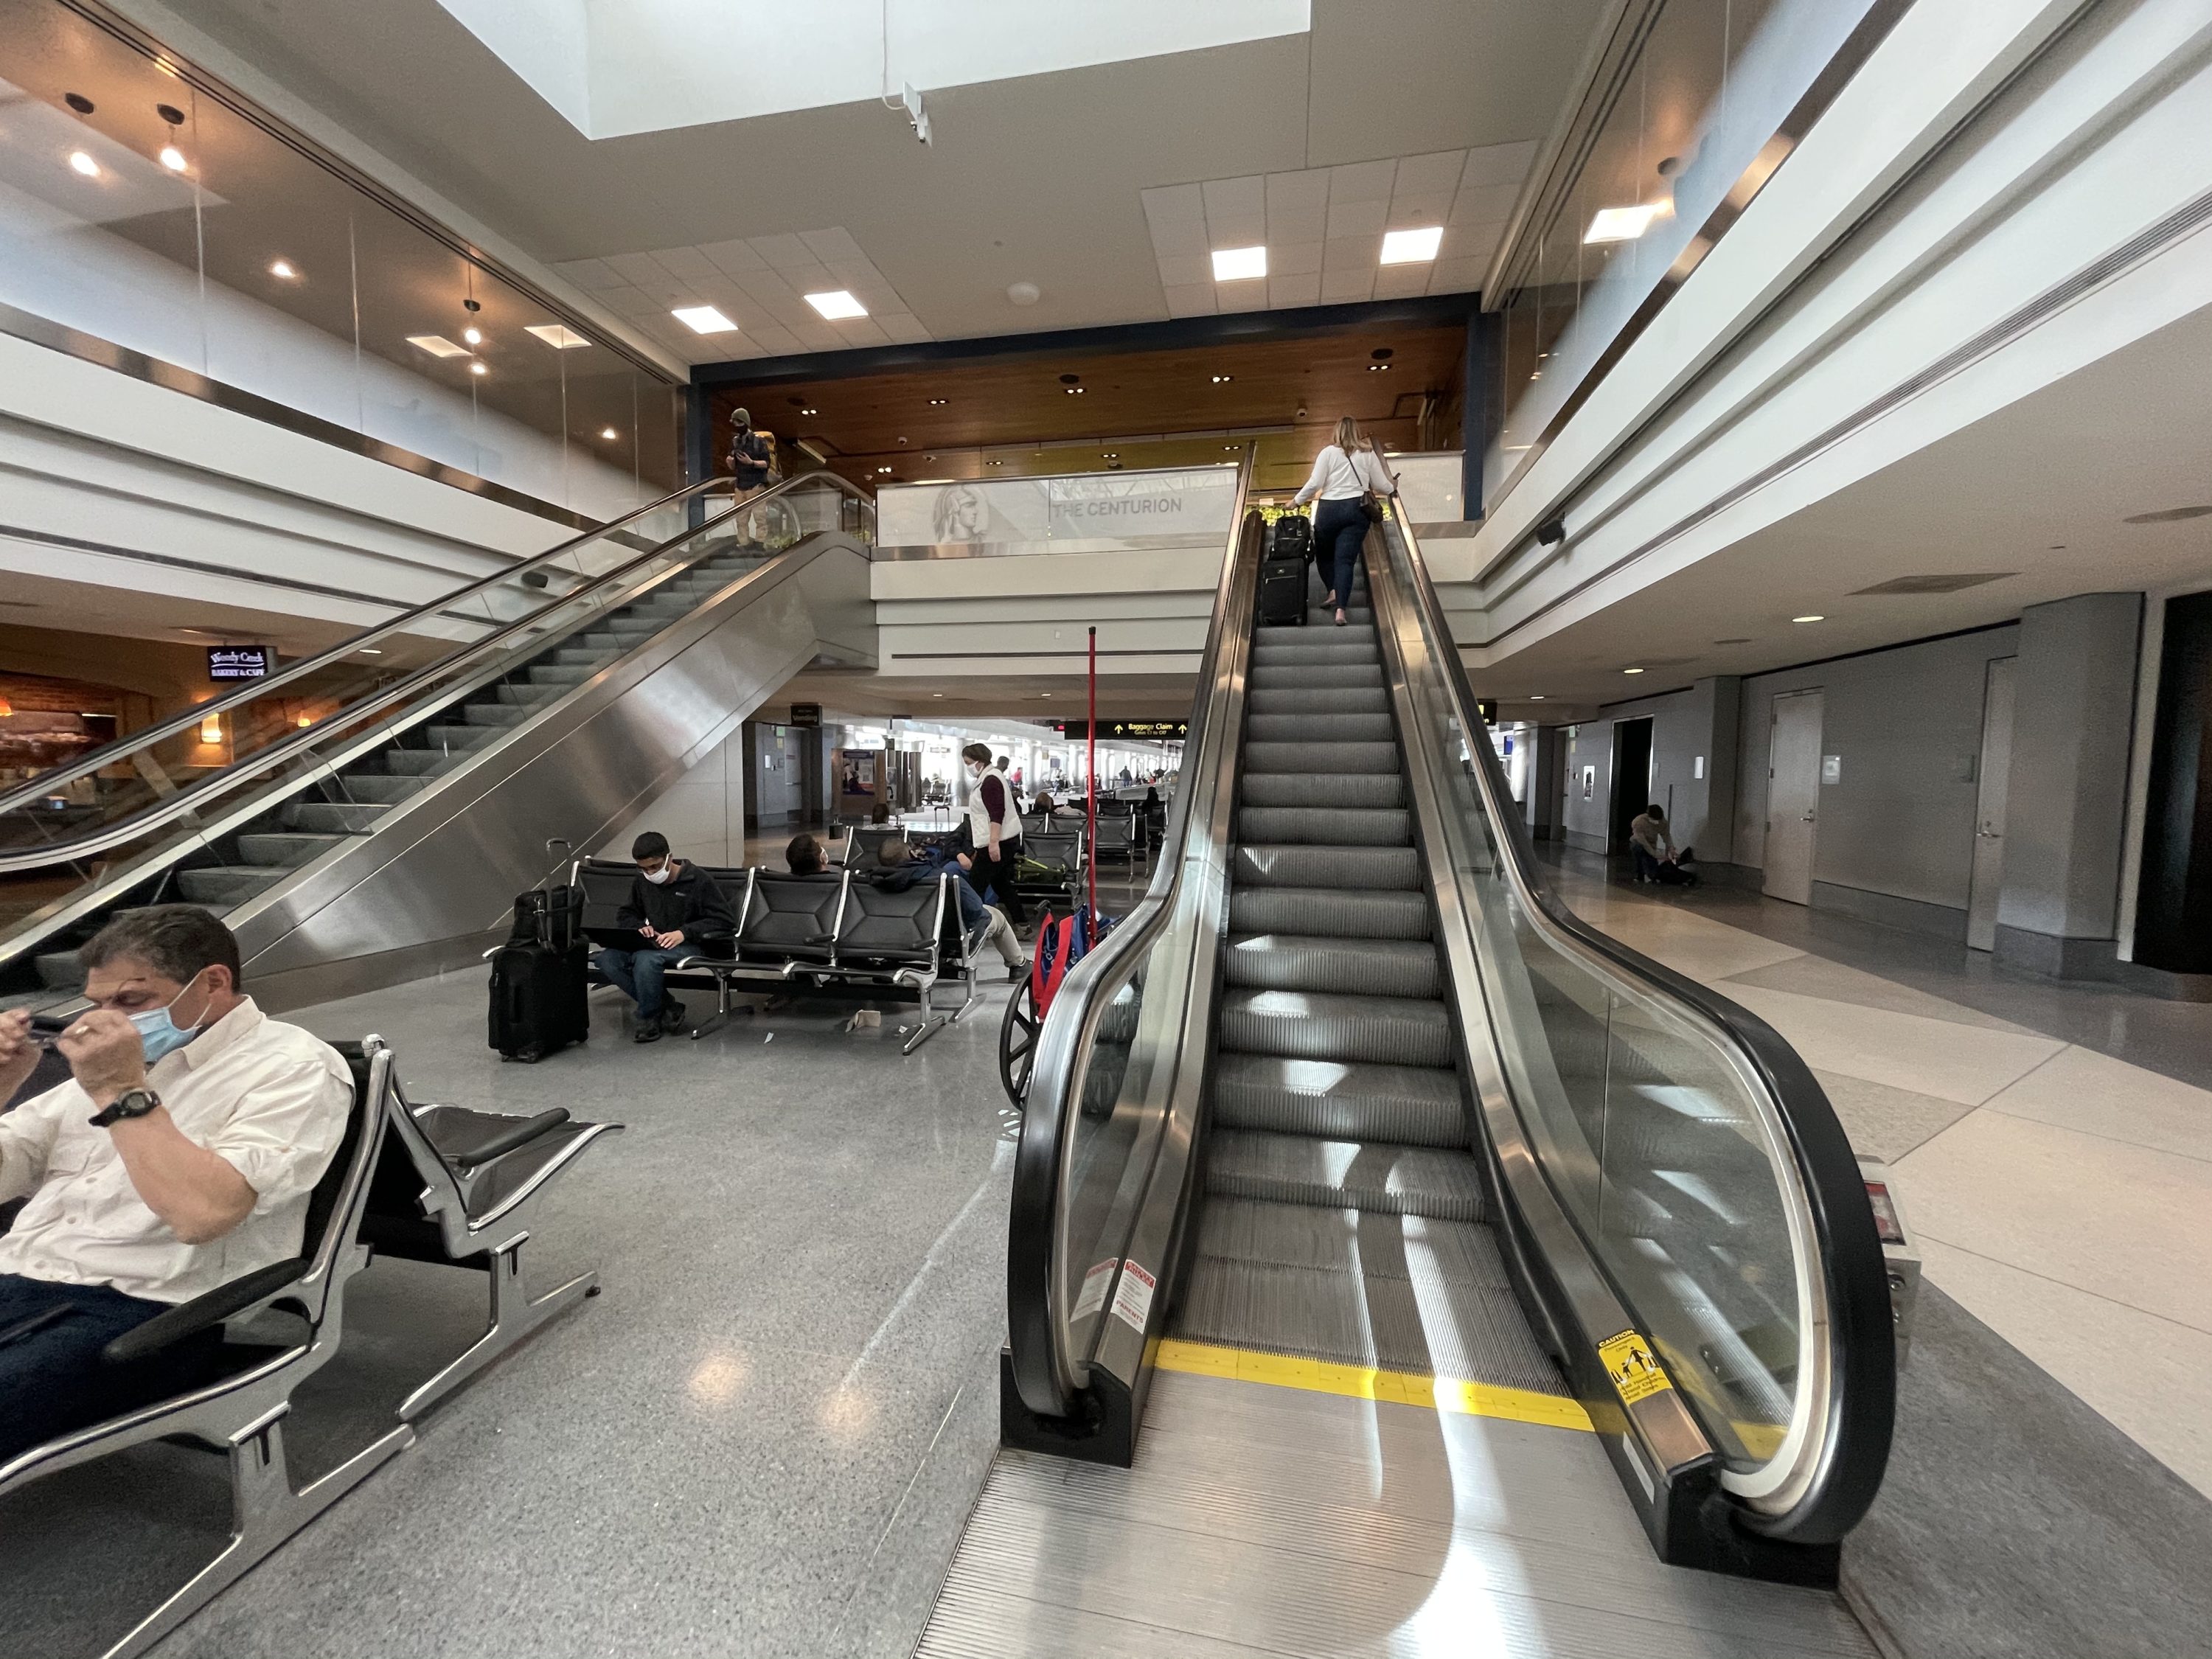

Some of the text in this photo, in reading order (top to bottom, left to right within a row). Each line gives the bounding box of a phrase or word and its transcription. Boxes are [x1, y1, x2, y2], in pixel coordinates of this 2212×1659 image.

[1052, 498, 1182, 517] THE CENTURION
[1128, 723, 1155, 731] Baggage
[1116, 1300, 1144, 1324] PARENTS
[1599, 1329, 1635, 1347] CAUTION
